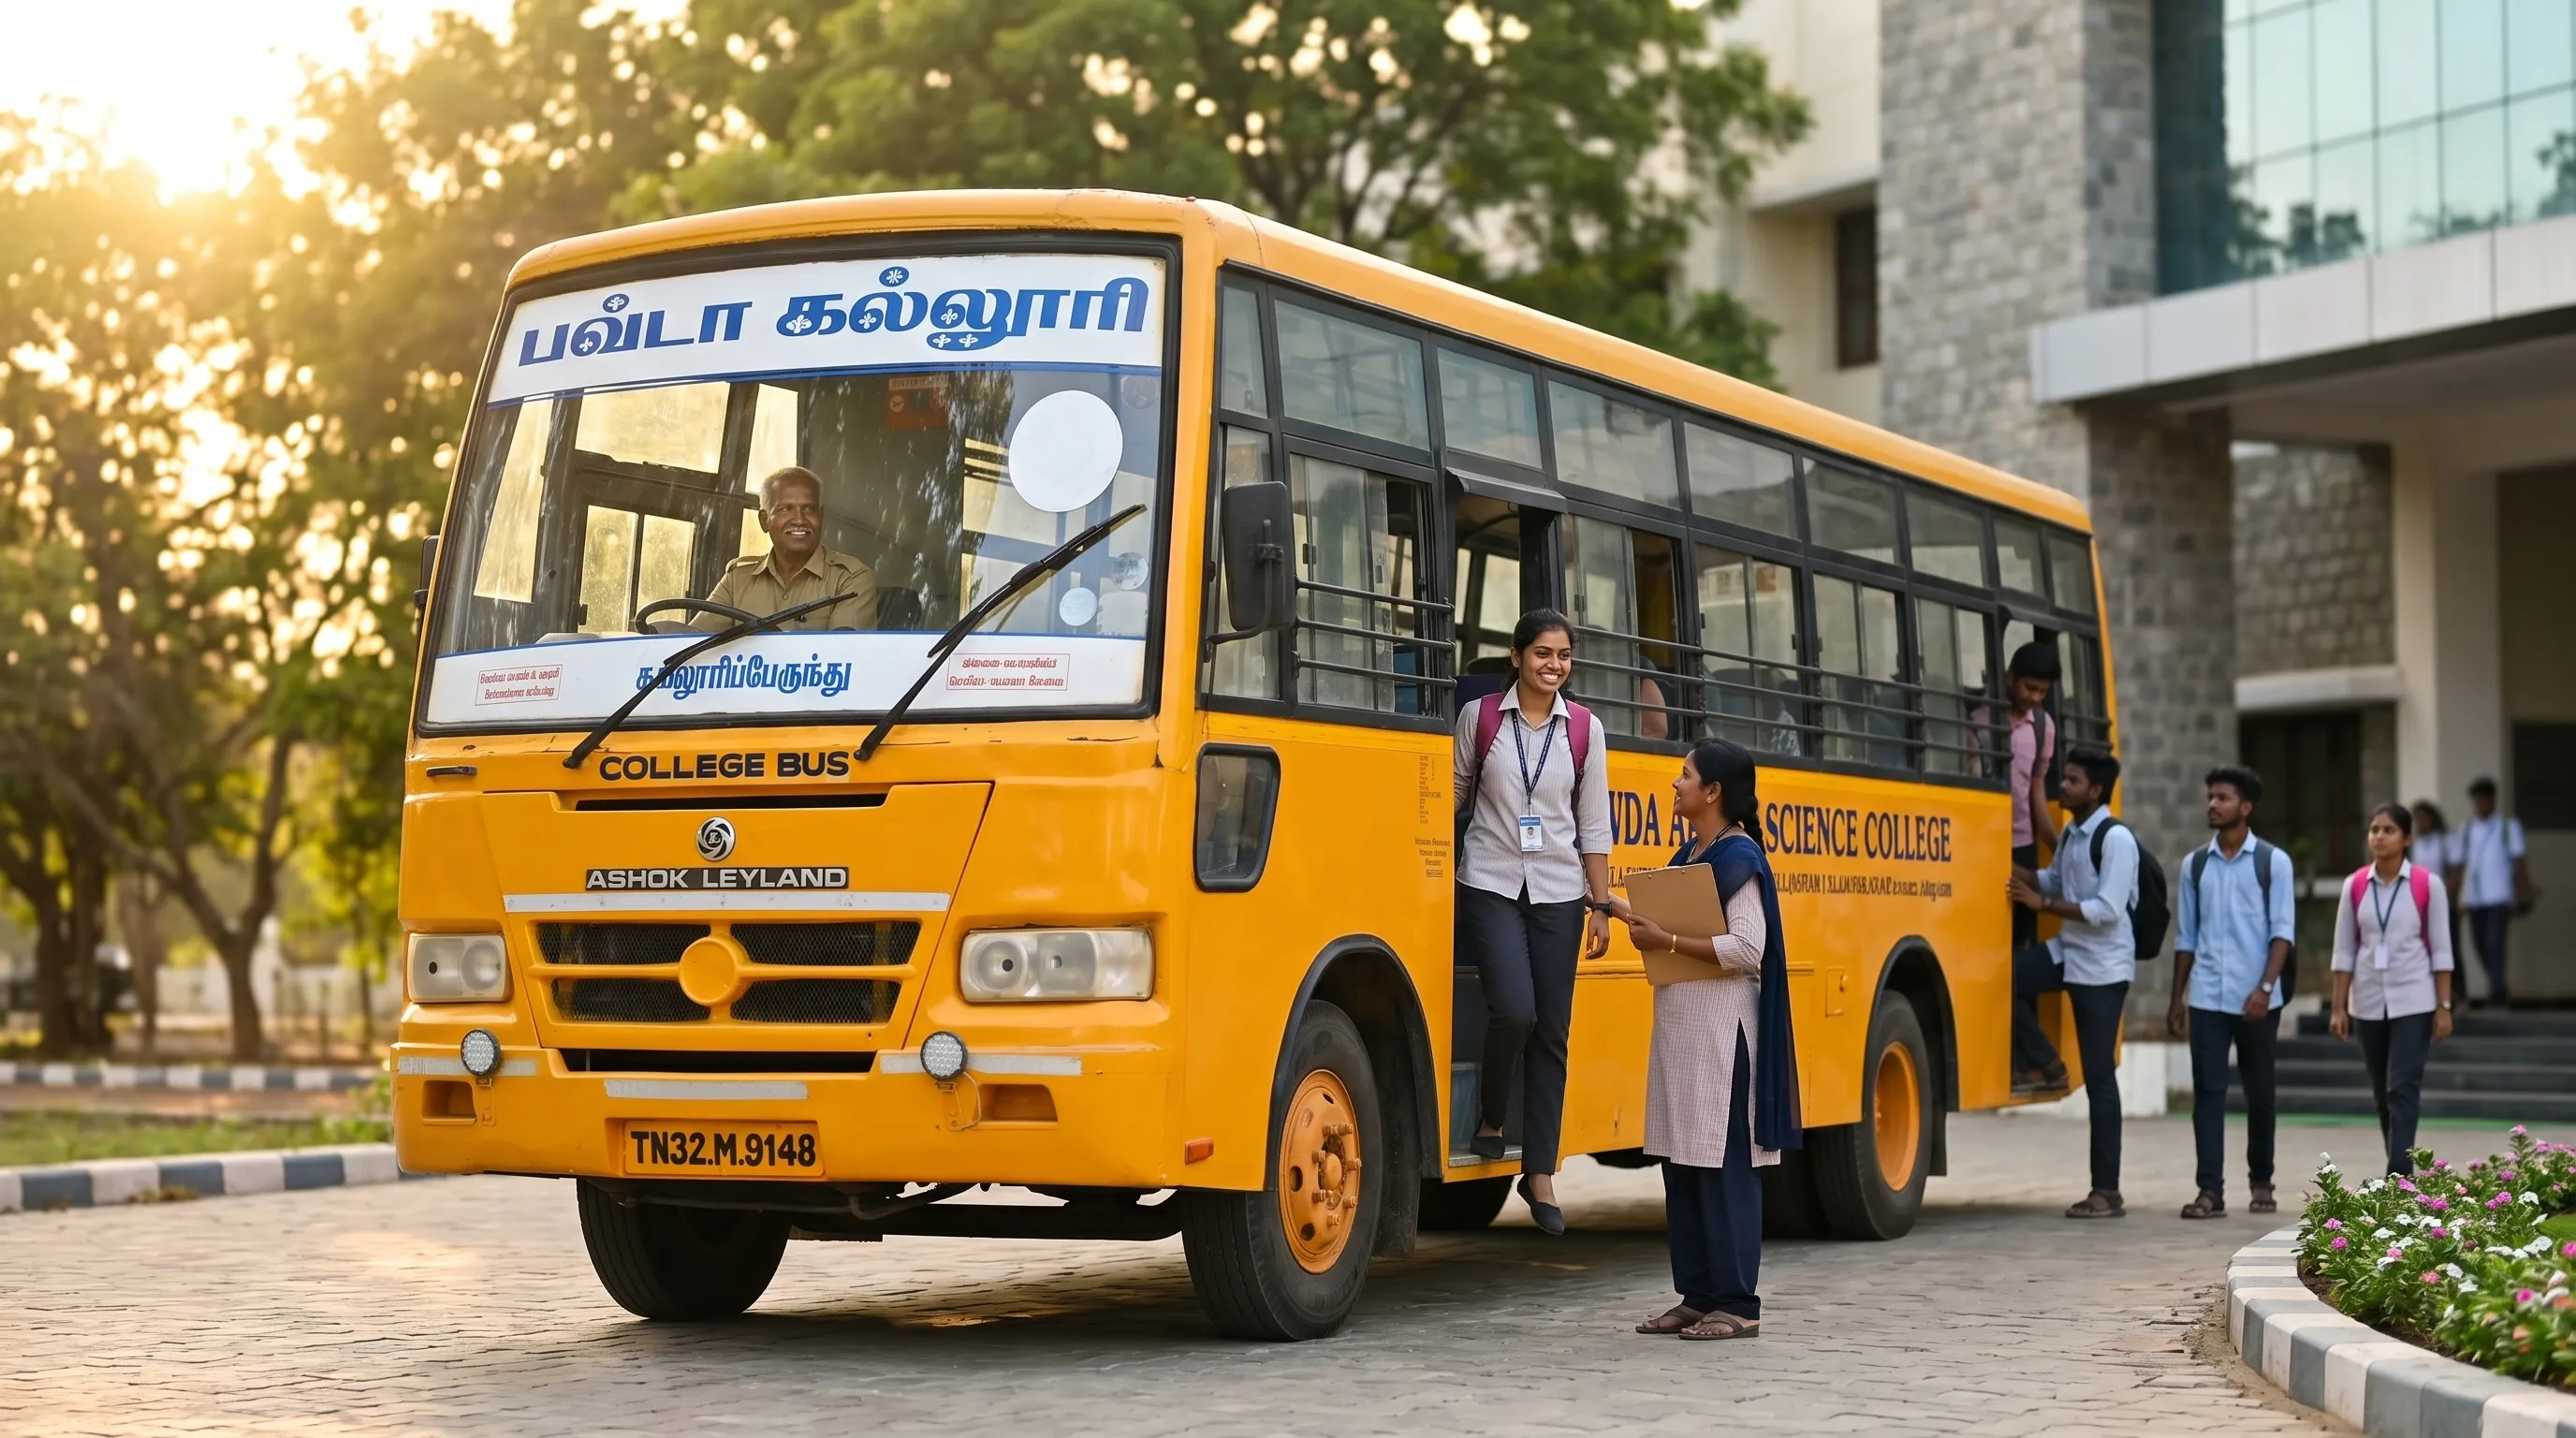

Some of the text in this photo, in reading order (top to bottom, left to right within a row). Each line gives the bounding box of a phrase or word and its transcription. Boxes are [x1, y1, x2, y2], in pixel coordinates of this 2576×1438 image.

[519, 266, 1149, 367] பவ்டா கல்லூரி
[637, 653, 853, 700] கலூரிப்பேருந்து
[599, 751, 849, 781] COLLEGE BUS
[1765, 802, 1858, 858] SCIENCE
[1865, 811, 1952, 862] COLLEGE
[586, 868, 846, 888] ASHOK LEYLAND
[630, 1131, 816, 1167] TN32.M.9148
